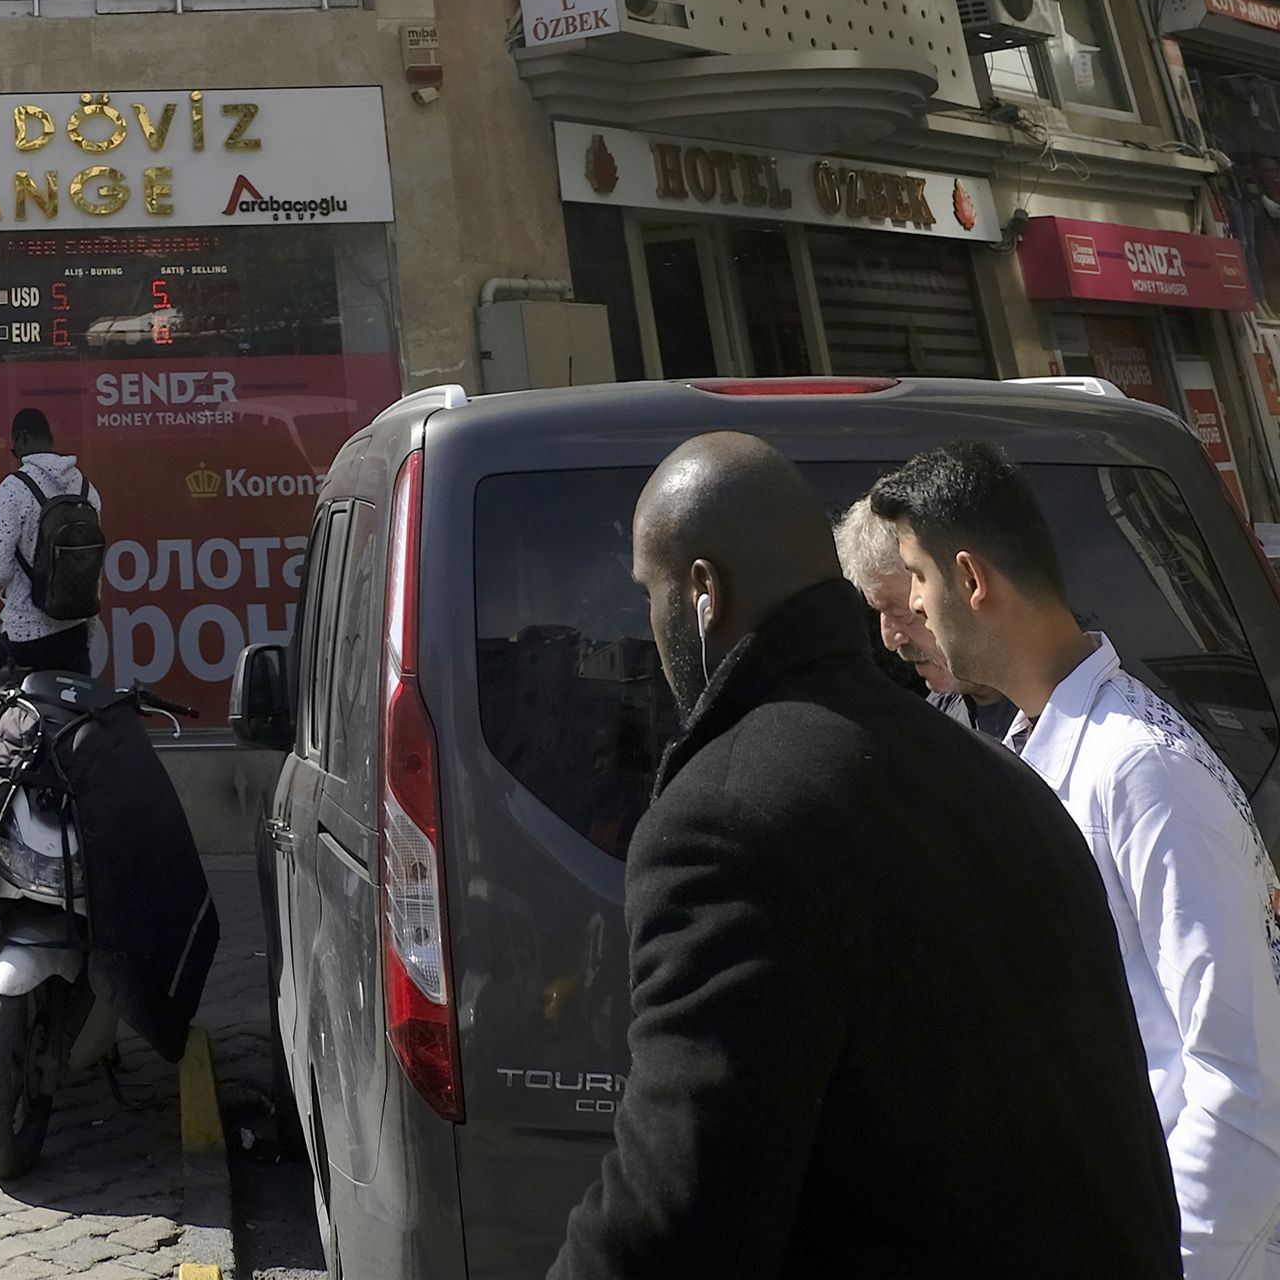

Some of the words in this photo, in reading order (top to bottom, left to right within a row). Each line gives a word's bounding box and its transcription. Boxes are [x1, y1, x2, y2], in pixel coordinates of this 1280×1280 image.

[532, 8, 610, 41] ÖZBEK
[13, 91, 263, 154] DÖVİZ
[650, 142, 792, 210] HOTEL
[90, 267, 123, 276] BUYING
[191, 266, 228, 274] SELLING
[11, 287, 40, 308] USD
[11, 322, 41, 343] EUR
[95, 371, 237, 406] SENDER
[96, 411, 154, 428] MONEY
[156, 409, 234, 426] TRANSFER
[104, 536, 308, 592] олота
